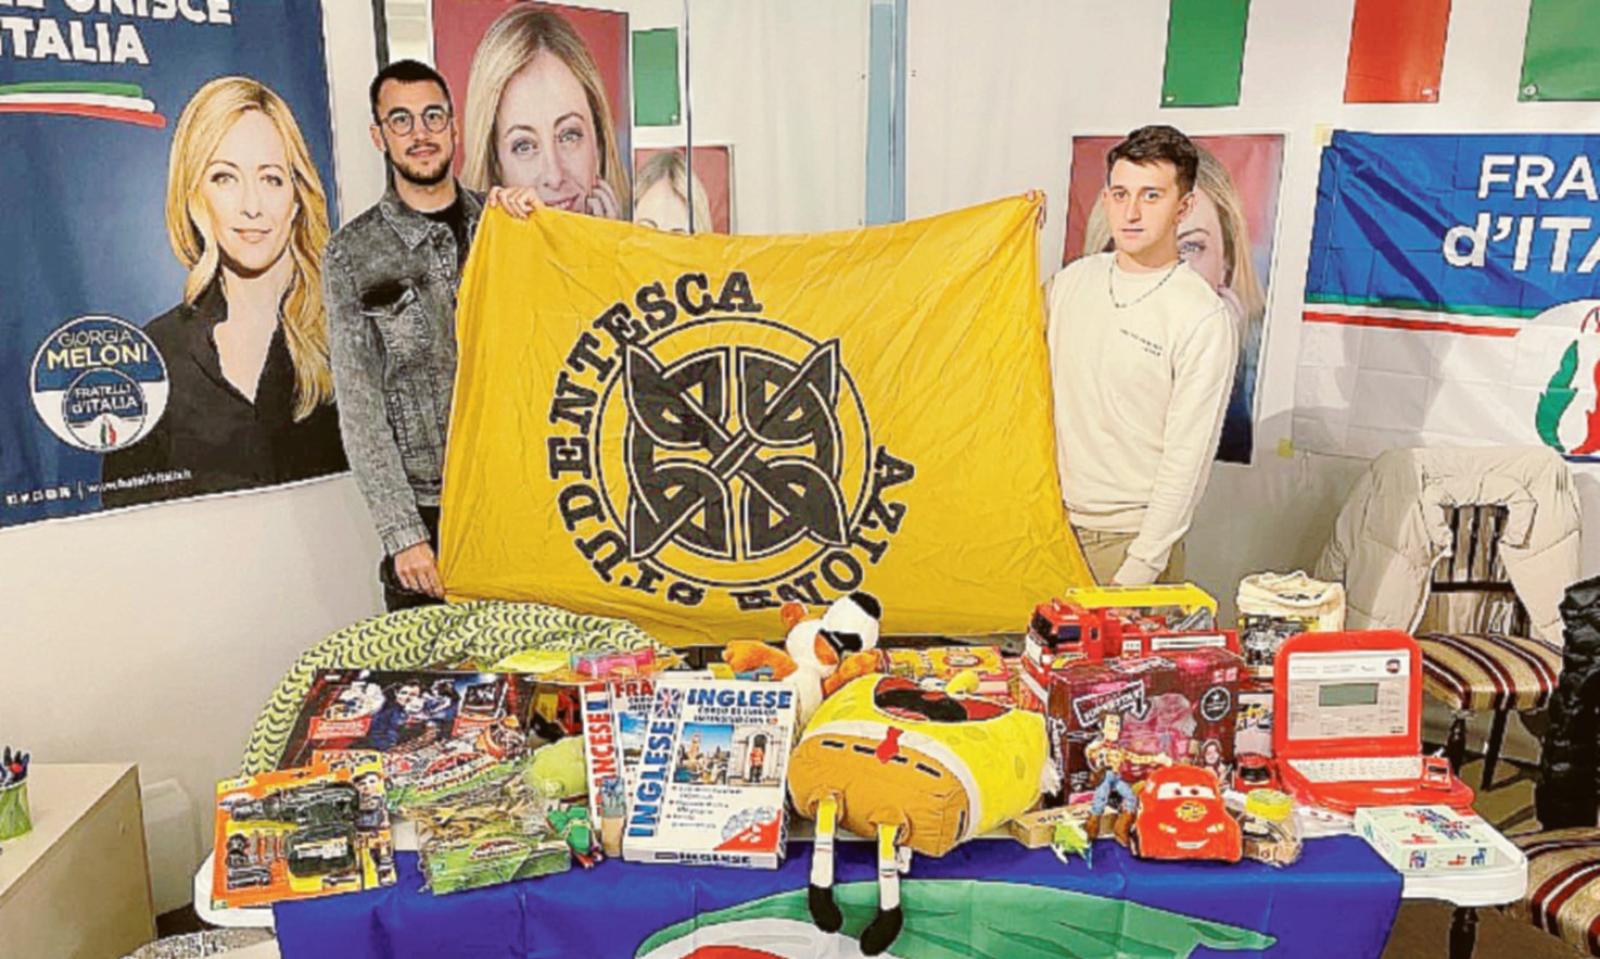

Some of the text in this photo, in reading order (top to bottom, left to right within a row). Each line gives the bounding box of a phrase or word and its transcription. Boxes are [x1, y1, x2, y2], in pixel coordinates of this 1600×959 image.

[0, 16, 150, 65] TALIA
[58, 330, 134, 347] GIORGIA
[47, 343, 148, 370] MELONI
[74, 383, 132, 398] FRATELLI
[71, 397, 139, 415] d'ITALIA
[687, 688, 793, 709] INGLESE
[627, 720, 676, 838] INGLESE
